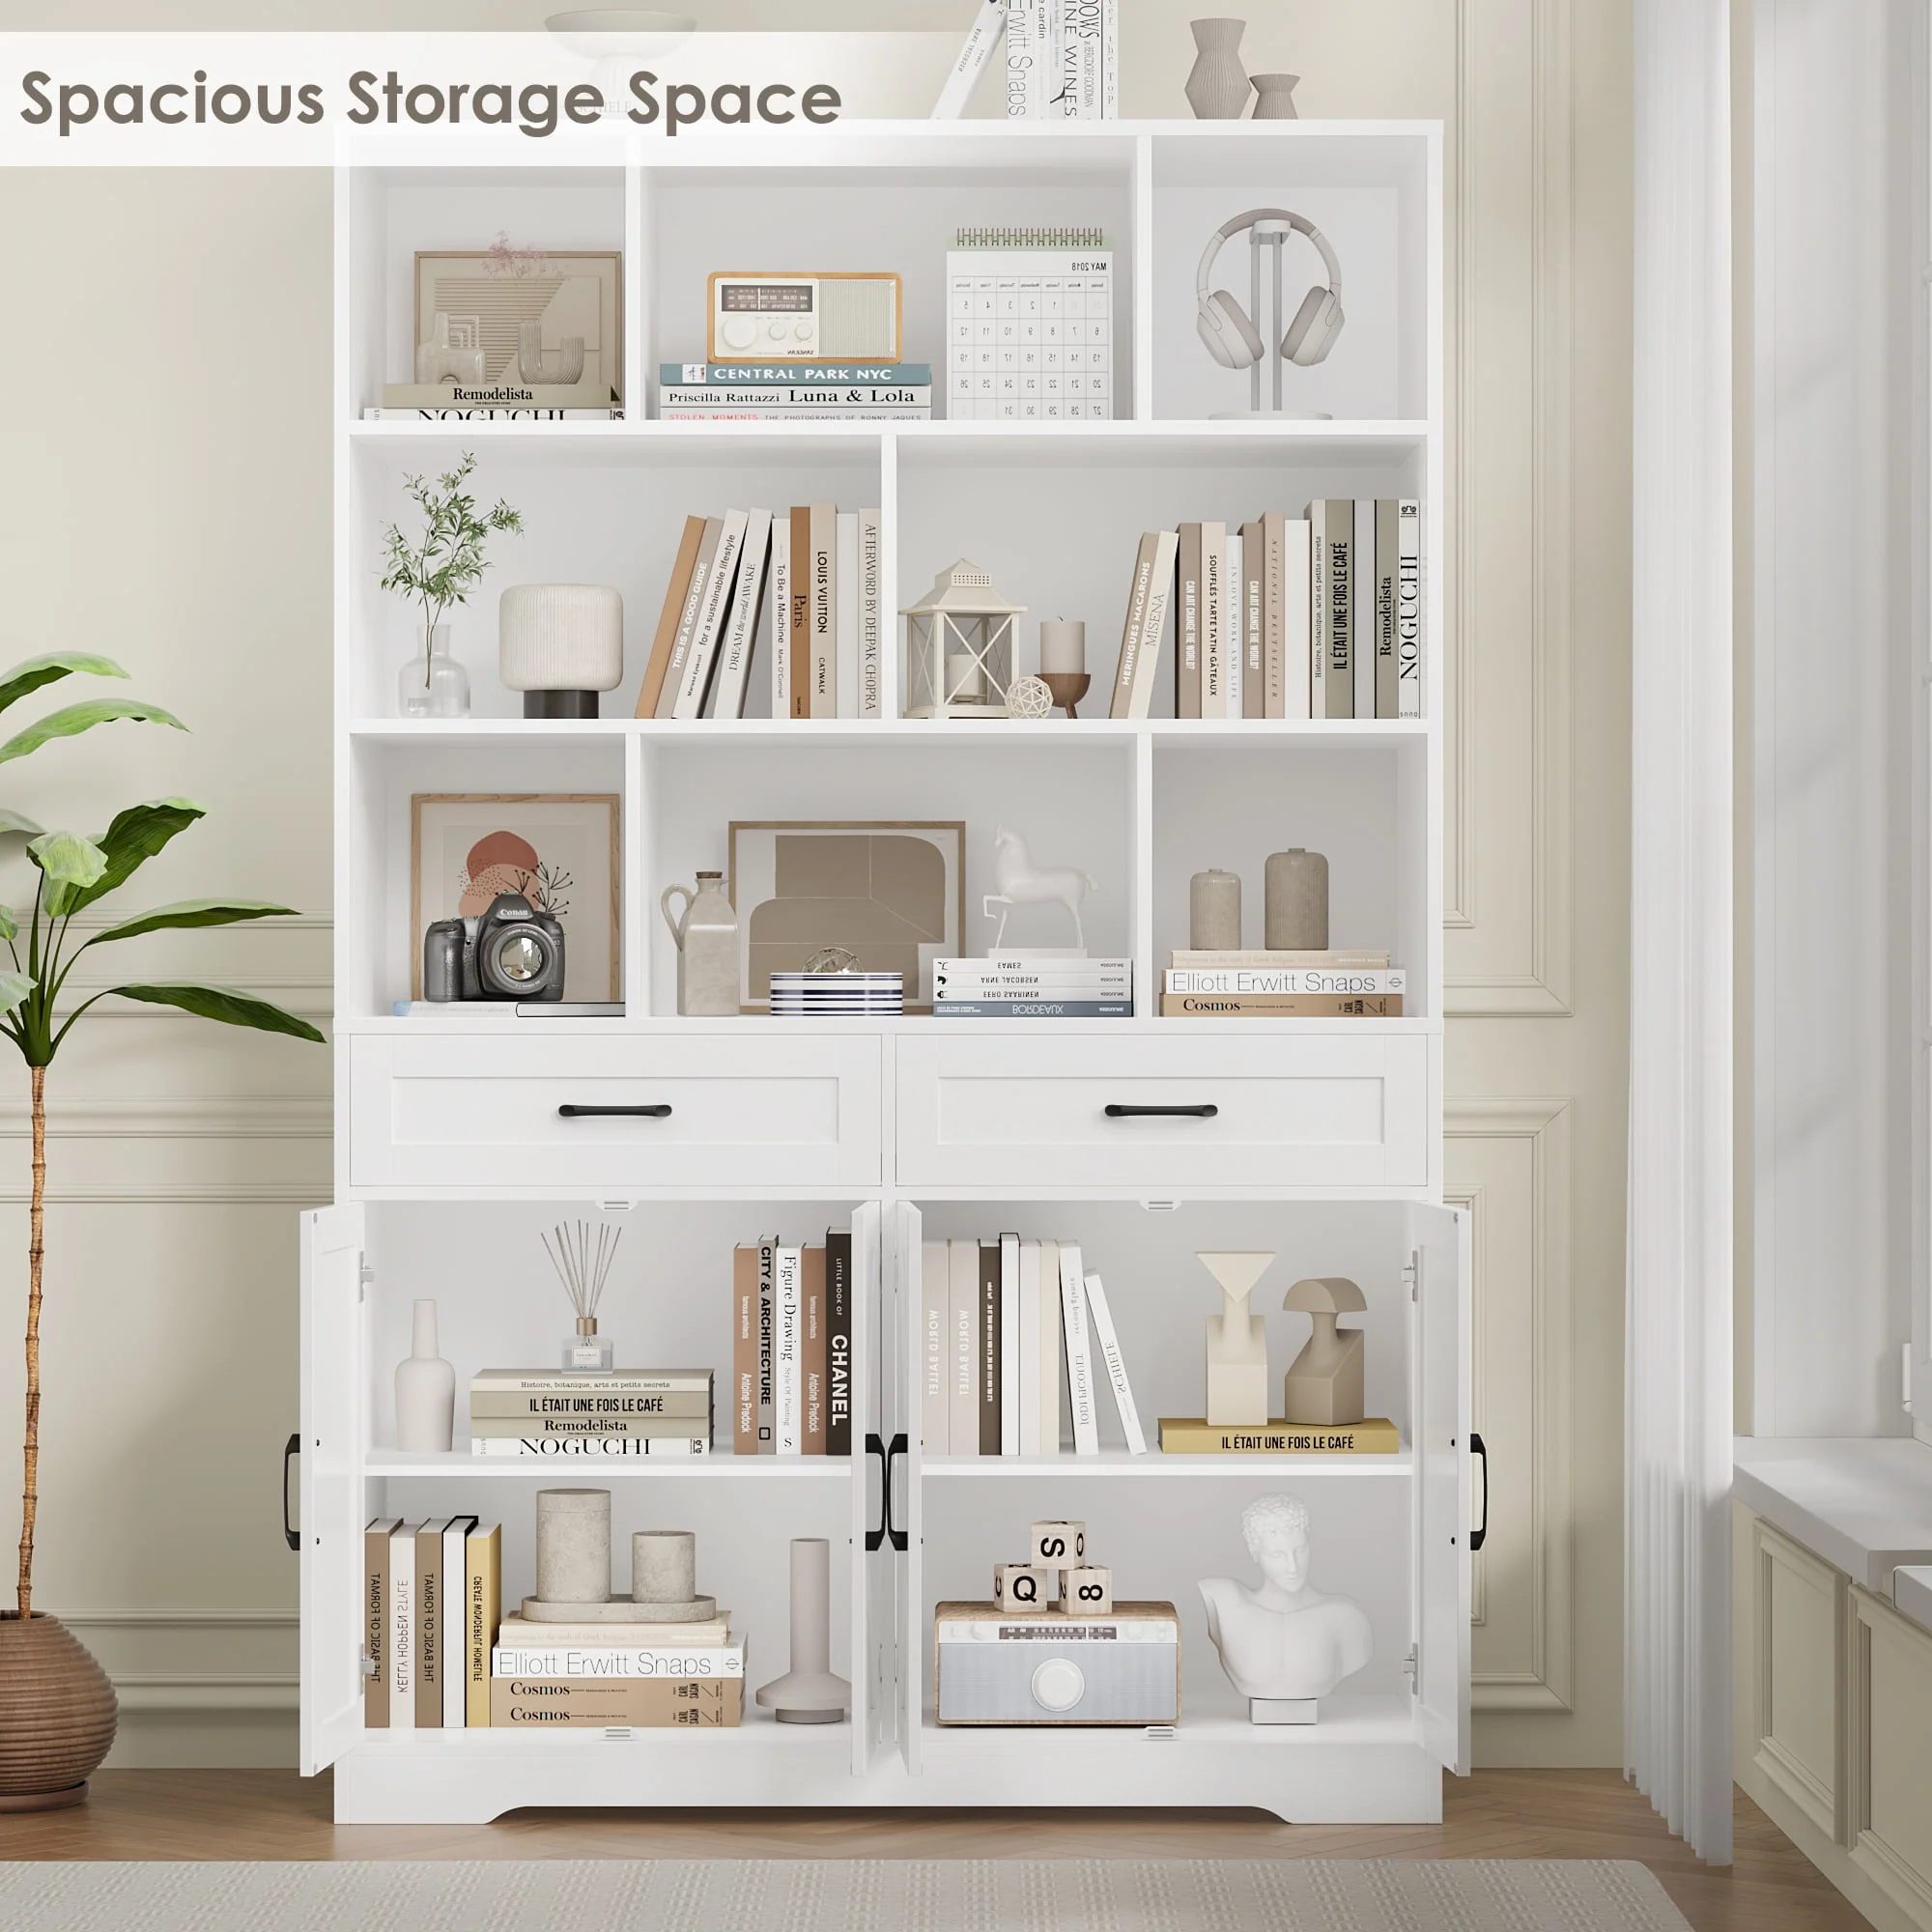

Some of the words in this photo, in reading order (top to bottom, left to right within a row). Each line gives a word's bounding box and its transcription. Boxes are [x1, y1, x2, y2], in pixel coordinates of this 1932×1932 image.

[1038, 7, 1047, 39] cardin
[1007, 55, 1034, 116] Snaps
[1063, 45, 1077, 117] WINES
[714, 368, 796, 380] CENTRAL
[805, 369, 849, 380] PARK
[857, 369, 892, 381] NYC
[453, 386, 534, 401] Remodelista
[669, 393, 721, 402] Priscilla
[726, 393, 780, 402] Rattazzi
[789, 389, 838, 402] Luna
[846, 389, 863, 402] &
[871, 389, 915, 402] Lola
[865, 524, 877, 596] AFTERWORD
[1329, 542, 1348, 568] CAFÉ
[693, 562, 708, 594] GUIDE
[777, 564, 786, 576] To
[817, 551, 828, 584] LOUIS
[1332, 569, 1348, 582] LE
[698, 633, 709, 646] for
[706, 571, 725, 623] sustainable
[719, 534, 735, 570] lifestyle
[777, 578, 786, 592] Be
[1315, 584, 1321, 593] et
[1332, 583, 1348, 606] FOIS
[685, 595, 698, 624] GOOD
[728, 633, 743, 670] DREAM
[742, 562, 755, 600] AWAKE
[794, 594, 808, 628] Paris
[817, 586, 828, 634] VUITTON
[865, 599, 877, 614] BY
[1332, 608, 1348, 629] UNE
[1378, 576, 1392, 657] Remodelista
[1400, 555, 1418, 680] NOGUCHI
[682, 626, 691, 635] A
[778, 603, 786, 643] Machine
[1122, 624, 1139, 686] MERINGUES
[1133, 561, 1151, 621] MACARONS
[679, 635, 688, 646] IS
[865, 617, 877, 661] DEEPAK
[1330, 630, 1348, 658] ÉTAIT
[672, 646, 685, 668] THIS
[1332, 660, 1348, 669] IL
[865, 664, 876, 710] CHOPRA
[1209, 656, 1219, 696] GÂTEAUX
[499, 908, 528, 917] Canon
[1173, 972, 1228, 992] Elliott
[1237, 972, 1296, 992] Erwitt
[1305, 972, 1377, 995] Snaps
[1182, 998, 1241, 1011] Cosmos
[760, 1246, 772, 1279] CITY
[760, 1282, 771, 1293] &
[780, 1257, 797, 1299] Figure
[836, 1305, 842, 1316] OF
[780, 1304, 797, 1361] Drawing
[760, 1296, 771, 1406] ARCHITECTURE
[741, 1373, 753, 1402] Antoine
[832, 1334, 848, 1426] CHANEL
[529, 1398, 540, 1412] IL
[542, 1396, 571, 1412] ÉTAIT
[573, 1398, 594, 1412] UNE
[596, 1398, 620, 1412] FOIS
[621, 1398, 635, 1412] LE
[637, 1395, 664, 1412] CAFÉ
[544, 1418, 628, 1432] Remodelista
[741, 1403, 753, 1434] Predock
[520, 1437, 650, 1455] NOGUCHI
[784, 1437, 792, 1447] S
[1221, 1436, 1232, 1449] IL
[1234, 1434, 1263, 1449] ÉTAIT
[1264, 1436, 1286, 1449] UNE
[1288, 1435, 1311, 1449] FOIS
[1313, 1435, 1326, 1449] LE
[1327, 1434, 1354, 1449] CAFÉ
[1039, 1537, 1065, 1558] S
[1012, 1575, 1037, 1604] Q
[1078, 1584, 1104, 1602] 8
[499, 1653, 557, 1674] Elliott
[568, 1653, 630, 1674] Erwitt
[639, 1653, 711, 1678] Snaps
[510, 1682, 571, 1695] Cosmos
[678, 1685, 689, 1697] CARL
[689, 1683, 699, 1699] SAGAN
